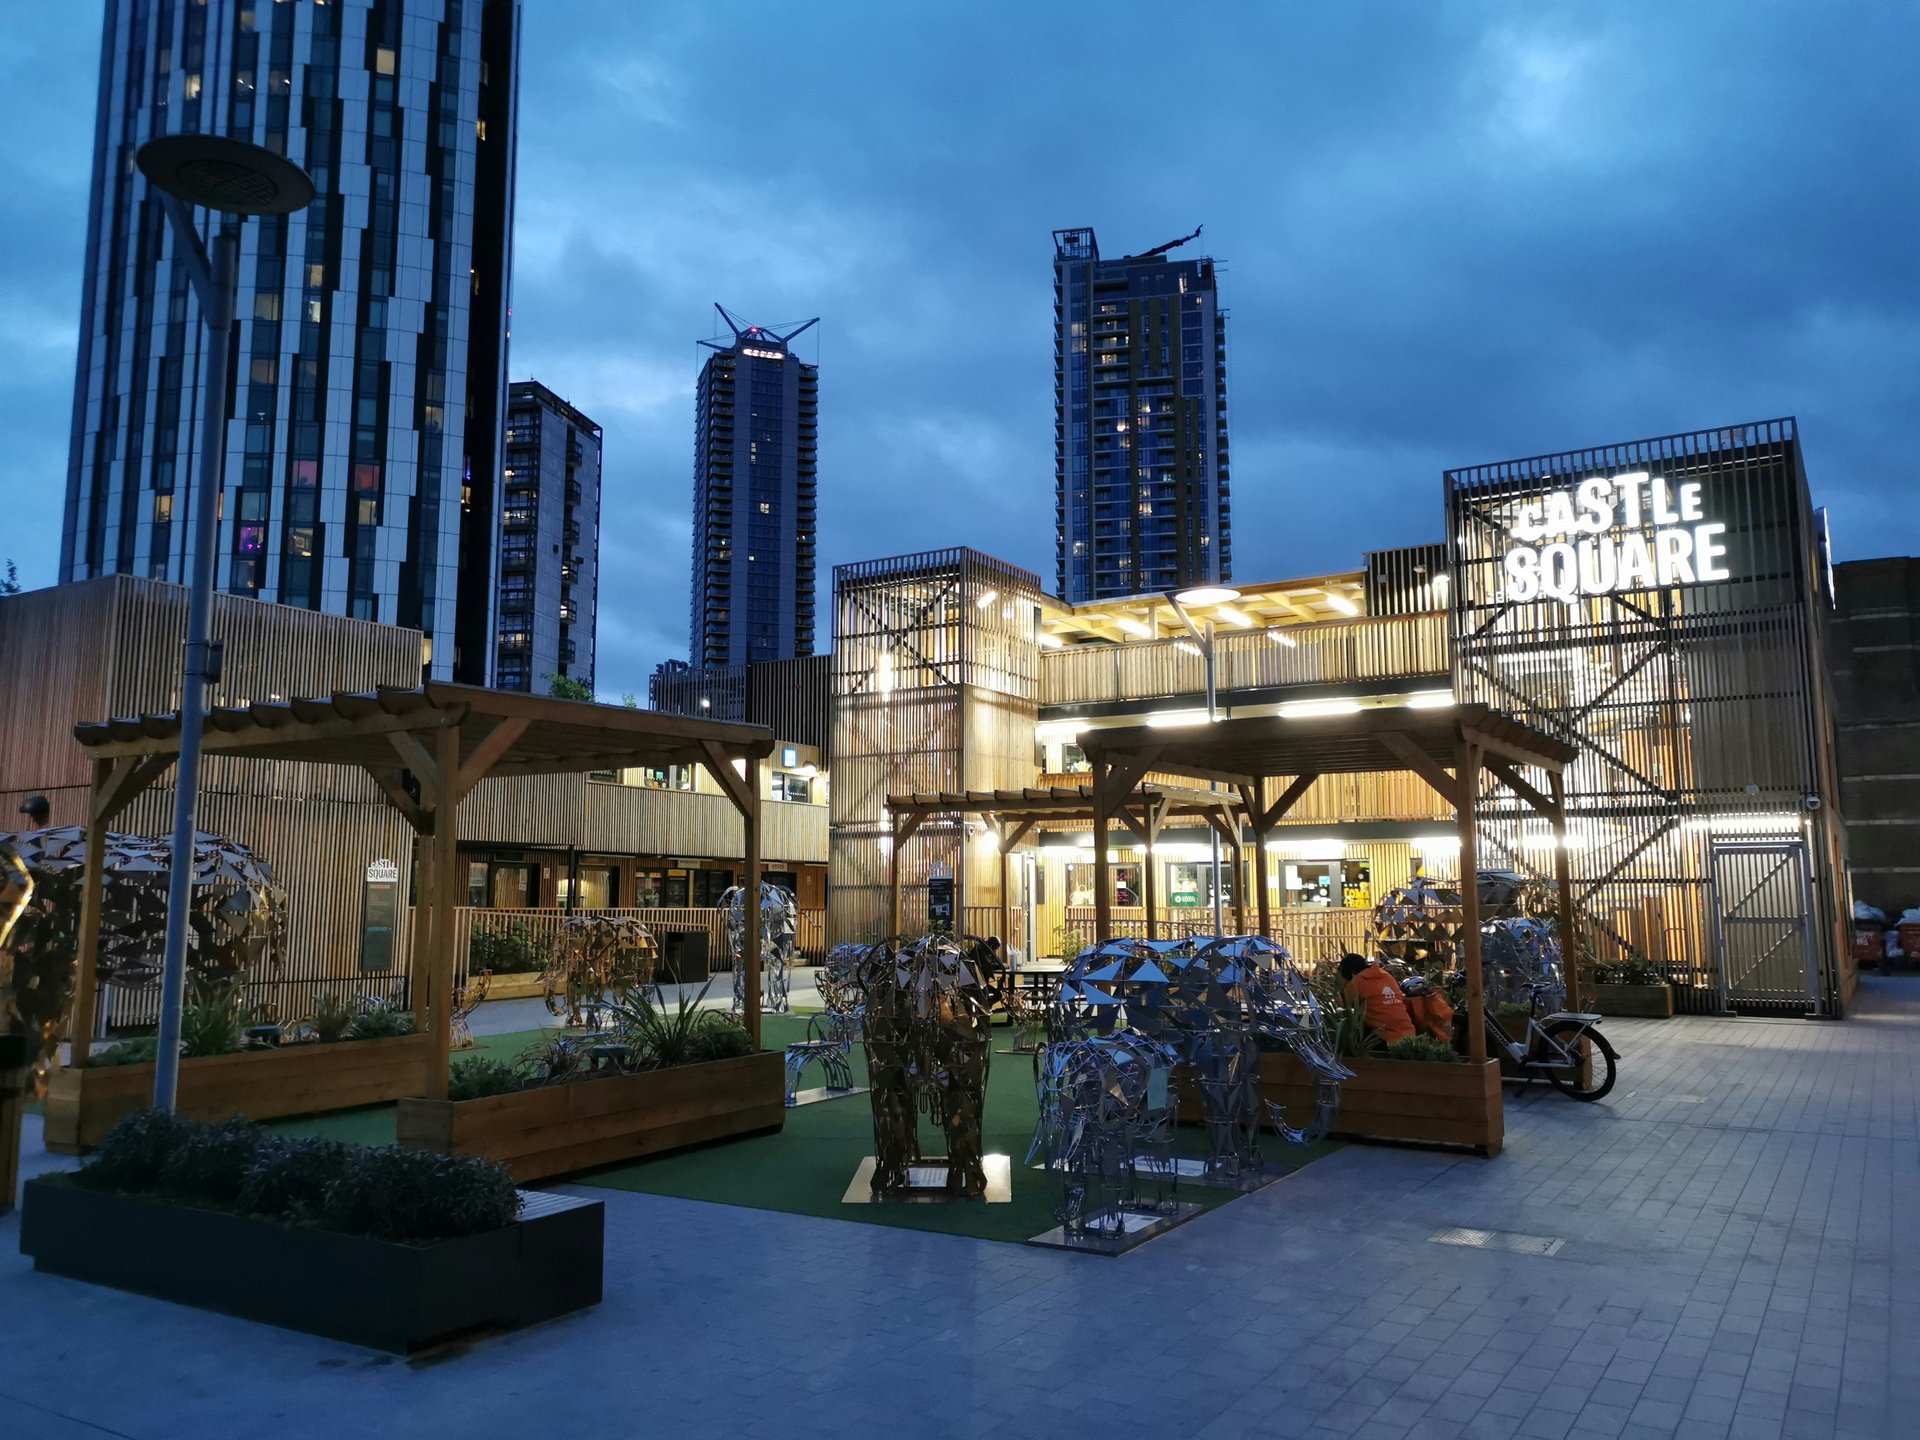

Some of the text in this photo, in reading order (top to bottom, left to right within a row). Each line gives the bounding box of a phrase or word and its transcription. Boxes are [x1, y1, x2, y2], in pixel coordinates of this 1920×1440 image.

[1510, 472, 1703, 541] CASTLE
[1504, 523, 1730, 604] SQUARE
[369, 869, 397, 879] SQUARE
